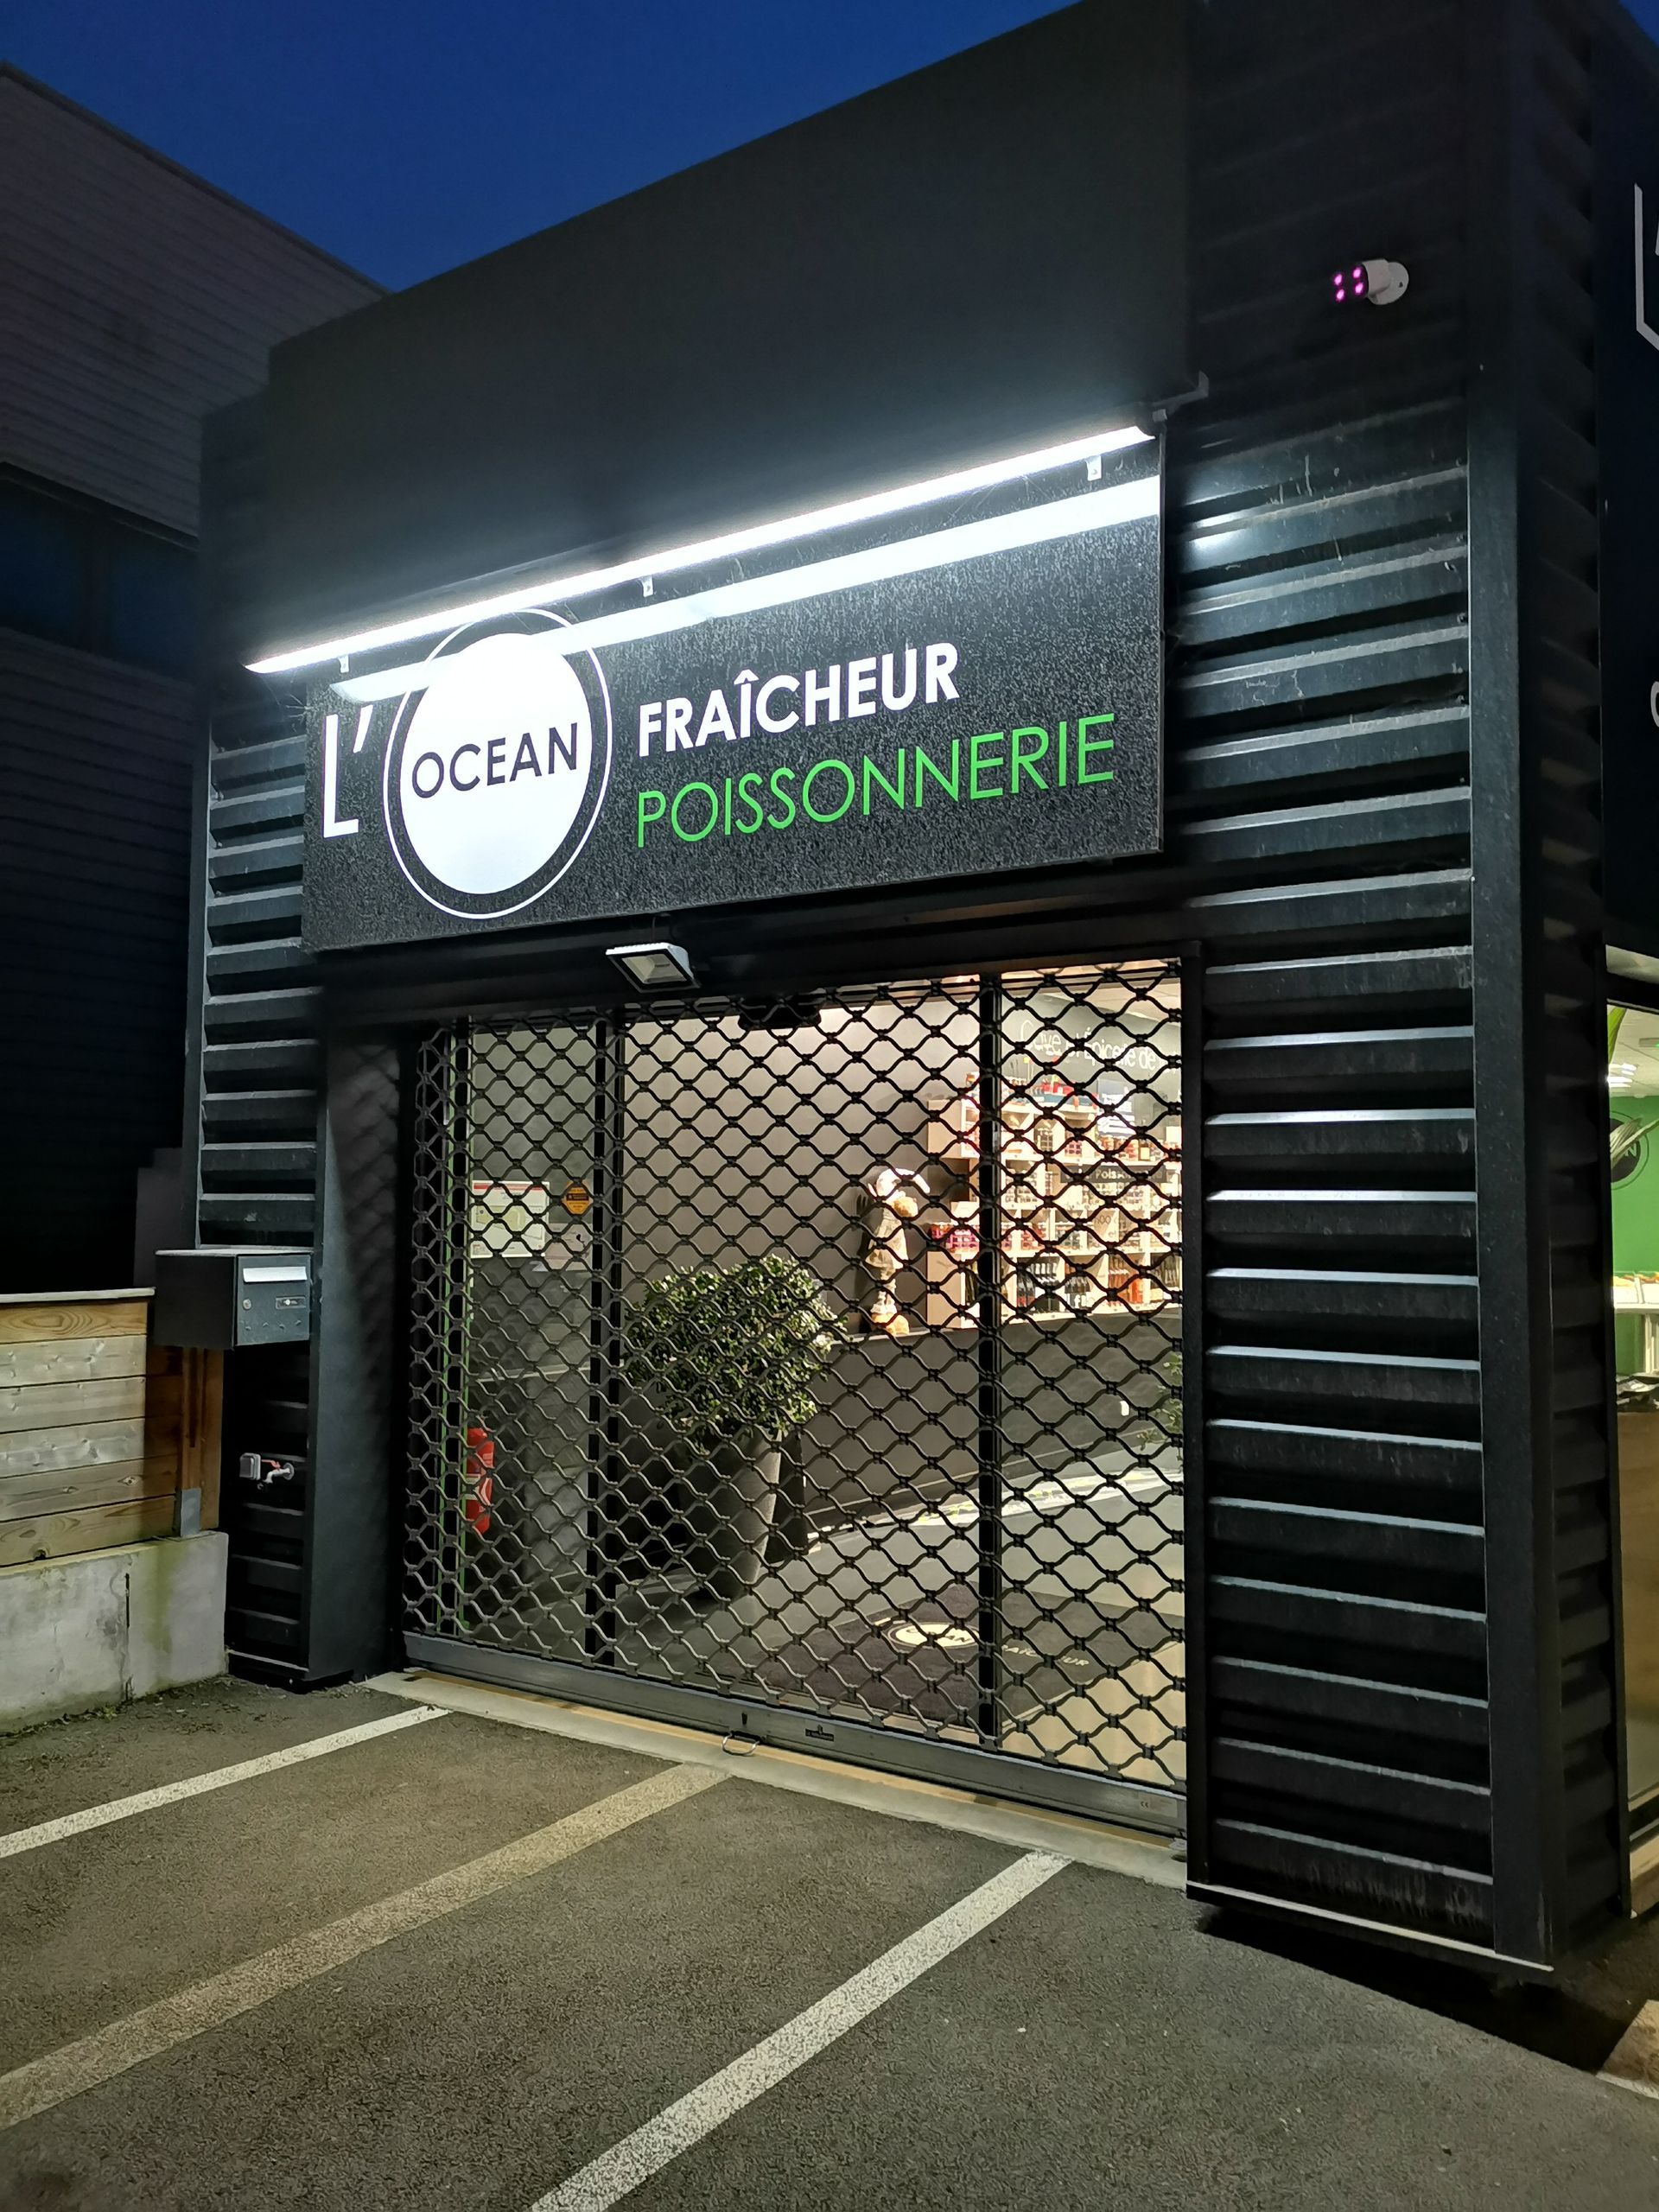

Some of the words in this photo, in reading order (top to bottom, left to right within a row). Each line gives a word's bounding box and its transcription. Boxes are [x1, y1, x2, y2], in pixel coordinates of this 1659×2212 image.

[639, 642, 960, 758] FRAÎCHEUR
[411, 722, 578, 798] OCEAN
[638, 714, 1115, 847] POISSONNERIE
